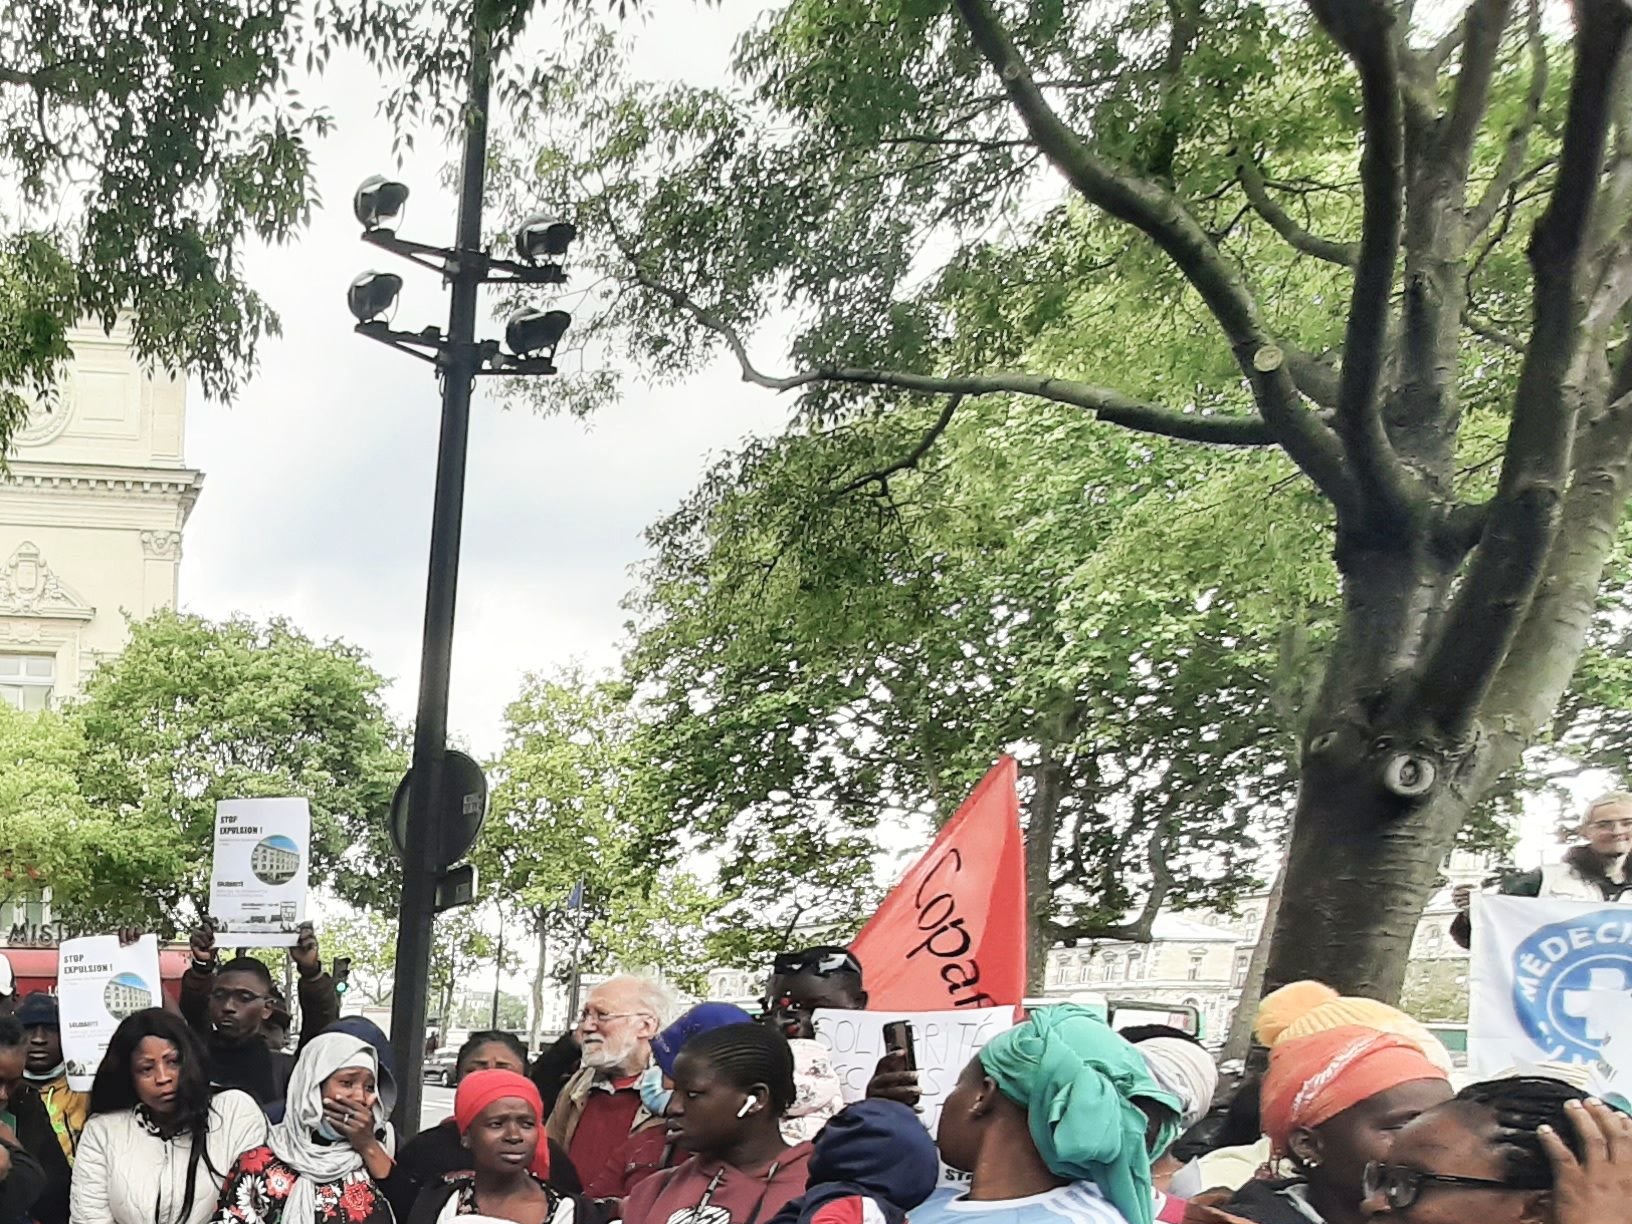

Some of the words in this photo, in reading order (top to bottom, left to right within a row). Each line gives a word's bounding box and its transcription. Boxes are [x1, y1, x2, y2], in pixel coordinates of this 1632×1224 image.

[220, 815, 238, 824] STOP
[64, 954, 84, 964] STOP
[64, 964, 108, 975] EXPULSION
